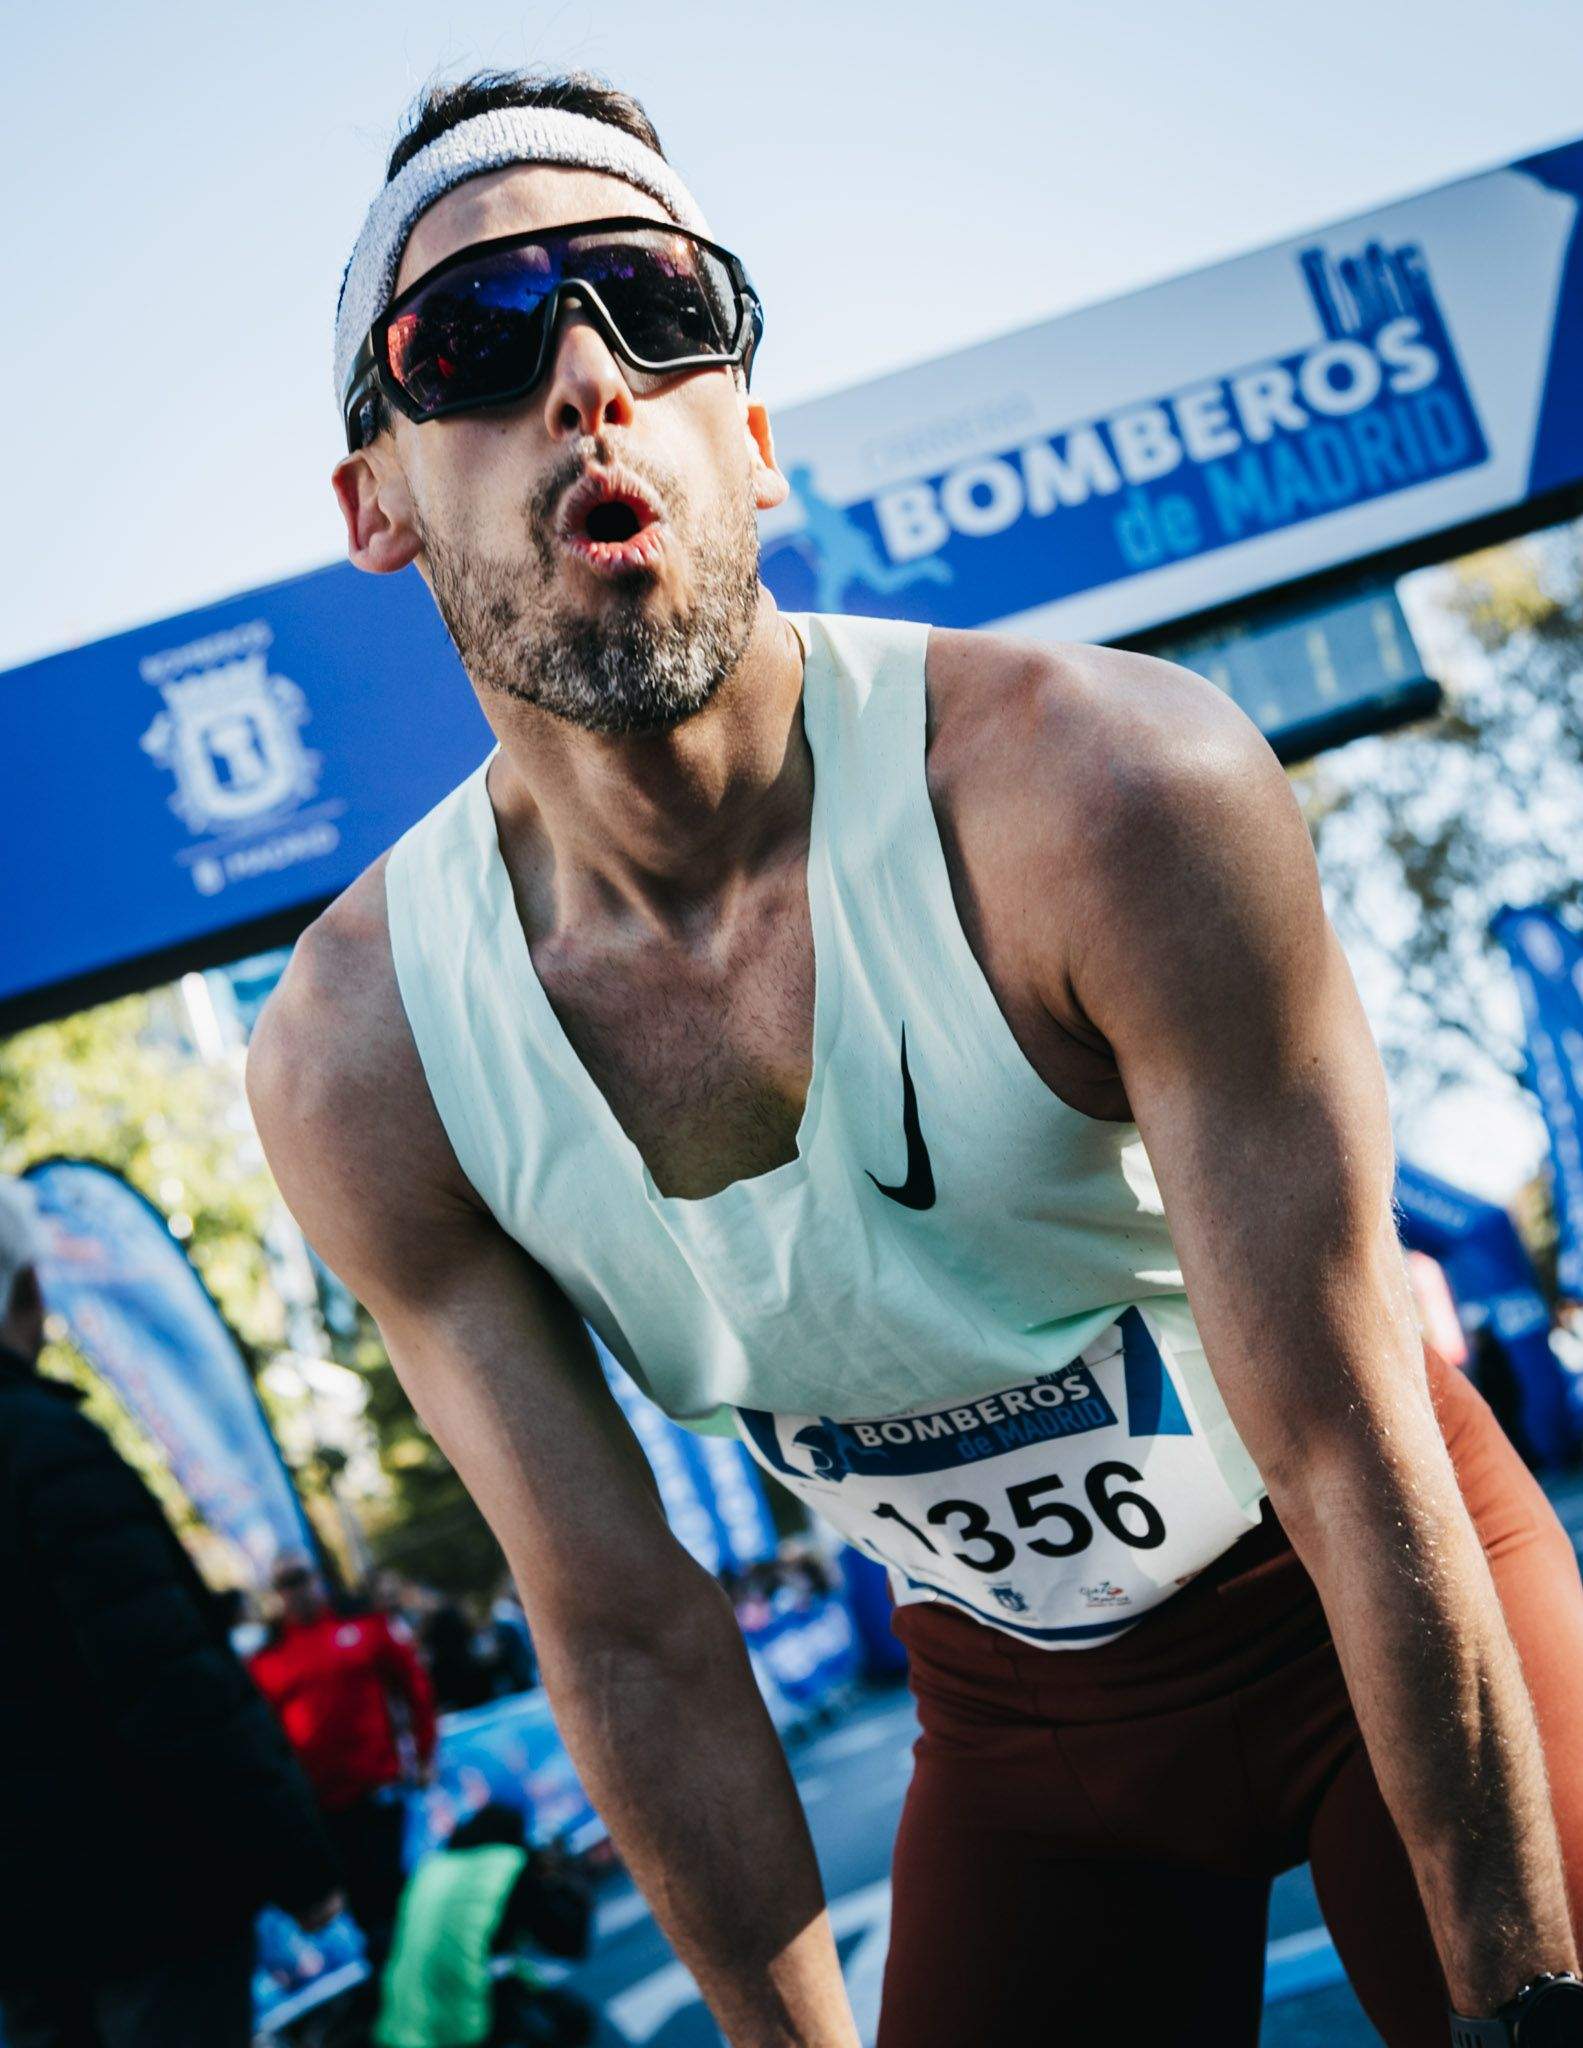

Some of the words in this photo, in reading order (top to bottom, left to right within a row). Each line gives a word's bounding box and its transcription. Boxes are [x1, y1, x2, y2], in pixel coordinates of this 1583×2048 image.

[872, 315, 1440, 562] BOMBEROS
[1113, 484, 1201, 569] de
[1205, 388, 1474, 541] MADRID
[854, 1375, 1091, 1448] BOMBEROS
[956, 1433, 992, 1460] de
[994, 1399, 1107, 1445] MADRID
[872, 1461, 1166, 1574] 1356
